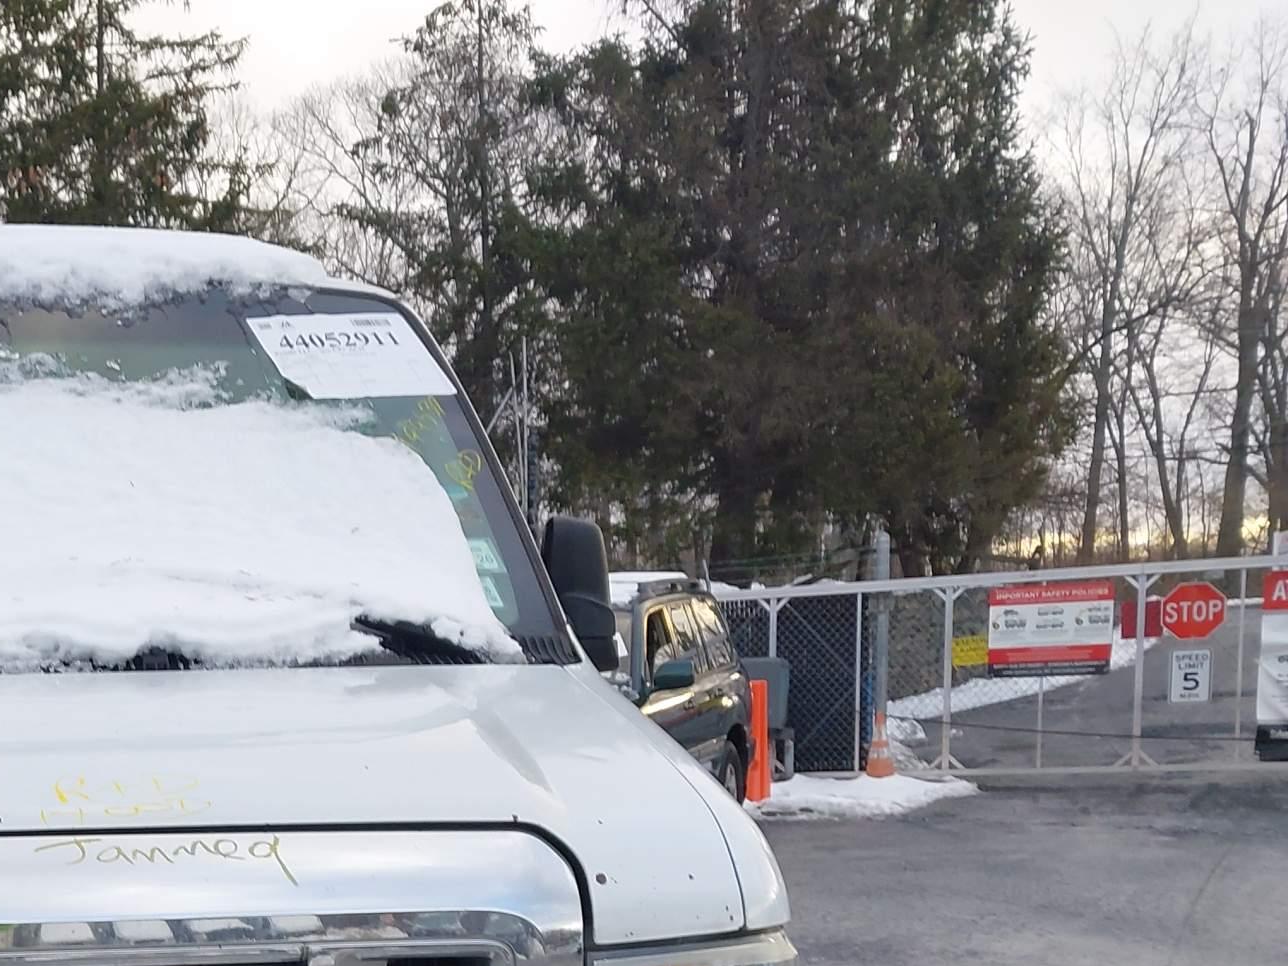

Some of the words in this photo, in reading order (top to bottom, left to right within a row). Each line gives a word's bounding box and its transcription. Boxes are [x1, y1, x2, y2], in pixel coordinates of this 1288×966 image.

[280, 331, 400, 349] 44052911
[996, 590, 1039, 600] IMPORTANT
[1041, 589, 1070, 598] SAFETY
[1072, 587, 1109, 596] POLICIES
[1165, 600, 1222, 624] STOP
[1175, 654, 1209, 662] SPEED
[1178, 662, 1204, 670] LIMIT
[1183, 672, 1200, 691] 5
